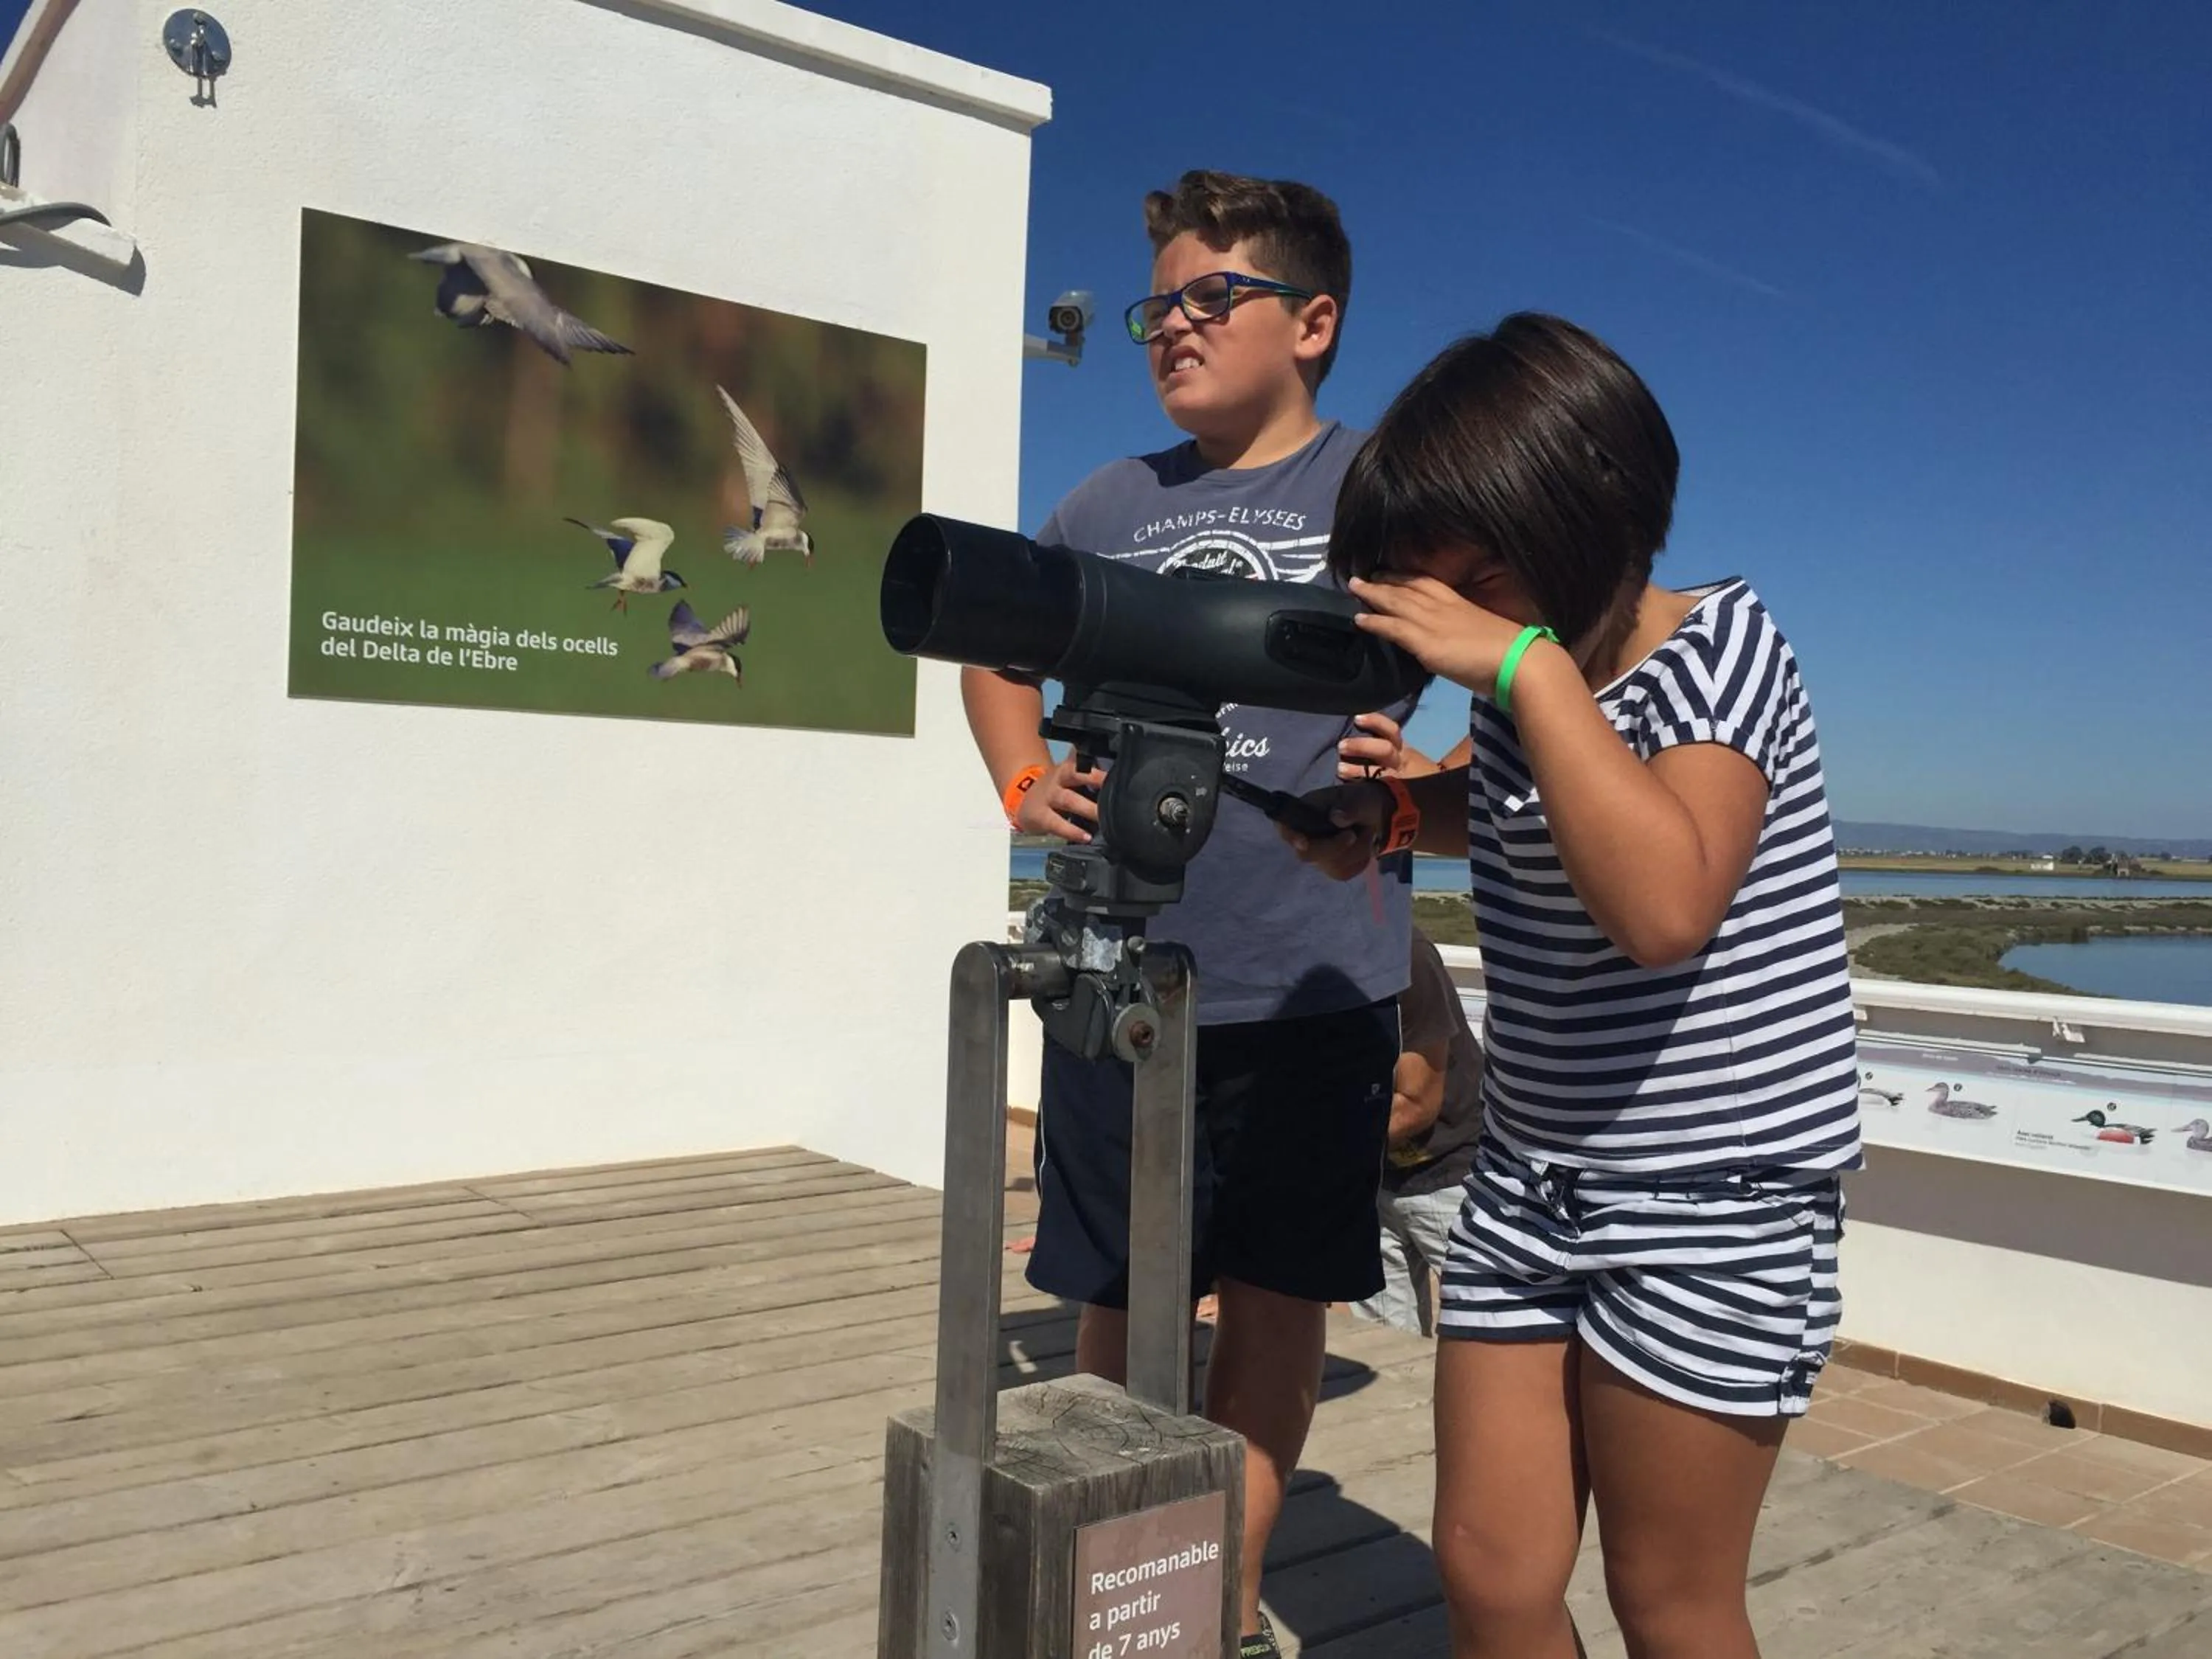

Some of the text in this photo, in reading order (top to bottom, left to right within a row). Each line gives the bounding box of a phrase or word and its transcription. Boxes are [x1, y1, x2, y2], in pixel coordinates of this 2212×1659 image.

[1133, 507, 1306, 543] CHAMPS-ELYSEES
[321, 611, 619, 656] Gaudeix la màgia dels ocells
[321, 637, 356, 658] del
[363, 640, 420, 662] Delta
[426, 649, 453, 666] de
[1091, 1540, 1219, 1594] Recomanable
[1089, 1590, 1161, 1630] a partir
[1088, 1622, 1180, 1659] de 7 anys
